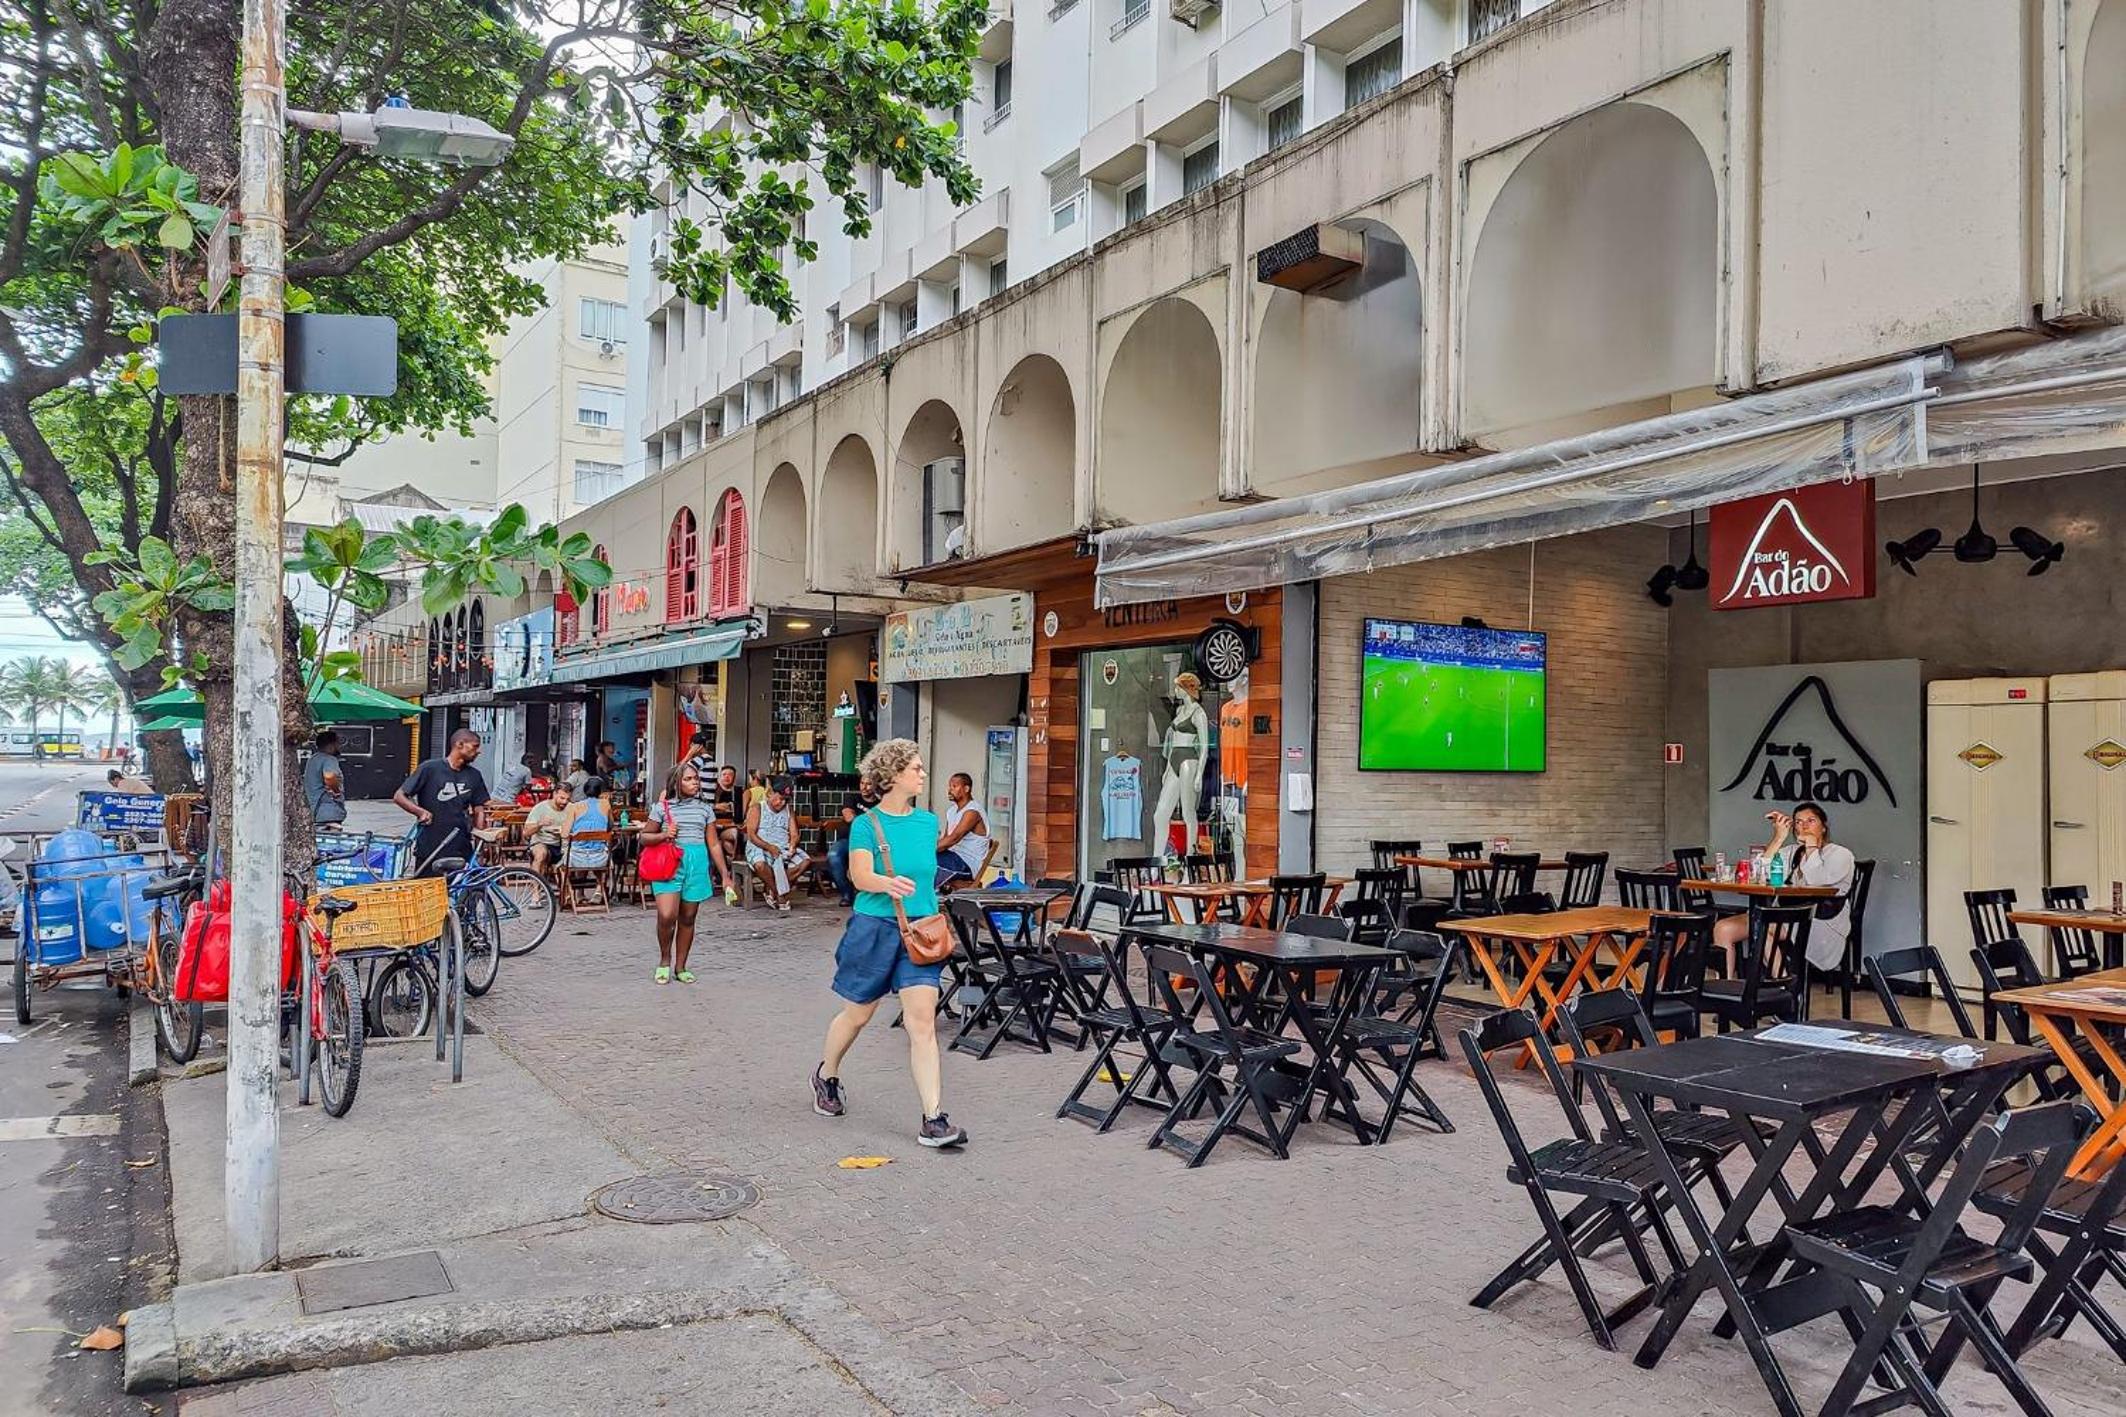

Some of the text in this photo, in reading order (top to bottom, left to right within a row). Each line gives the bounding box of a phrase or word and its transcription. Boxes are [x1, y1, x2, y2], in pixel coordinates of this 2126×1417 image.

[1755, 549, 1790, 564] Bar do
[1743, 558, 1832, 599] Adão
[1752, 757, 1869, 804] Adão
